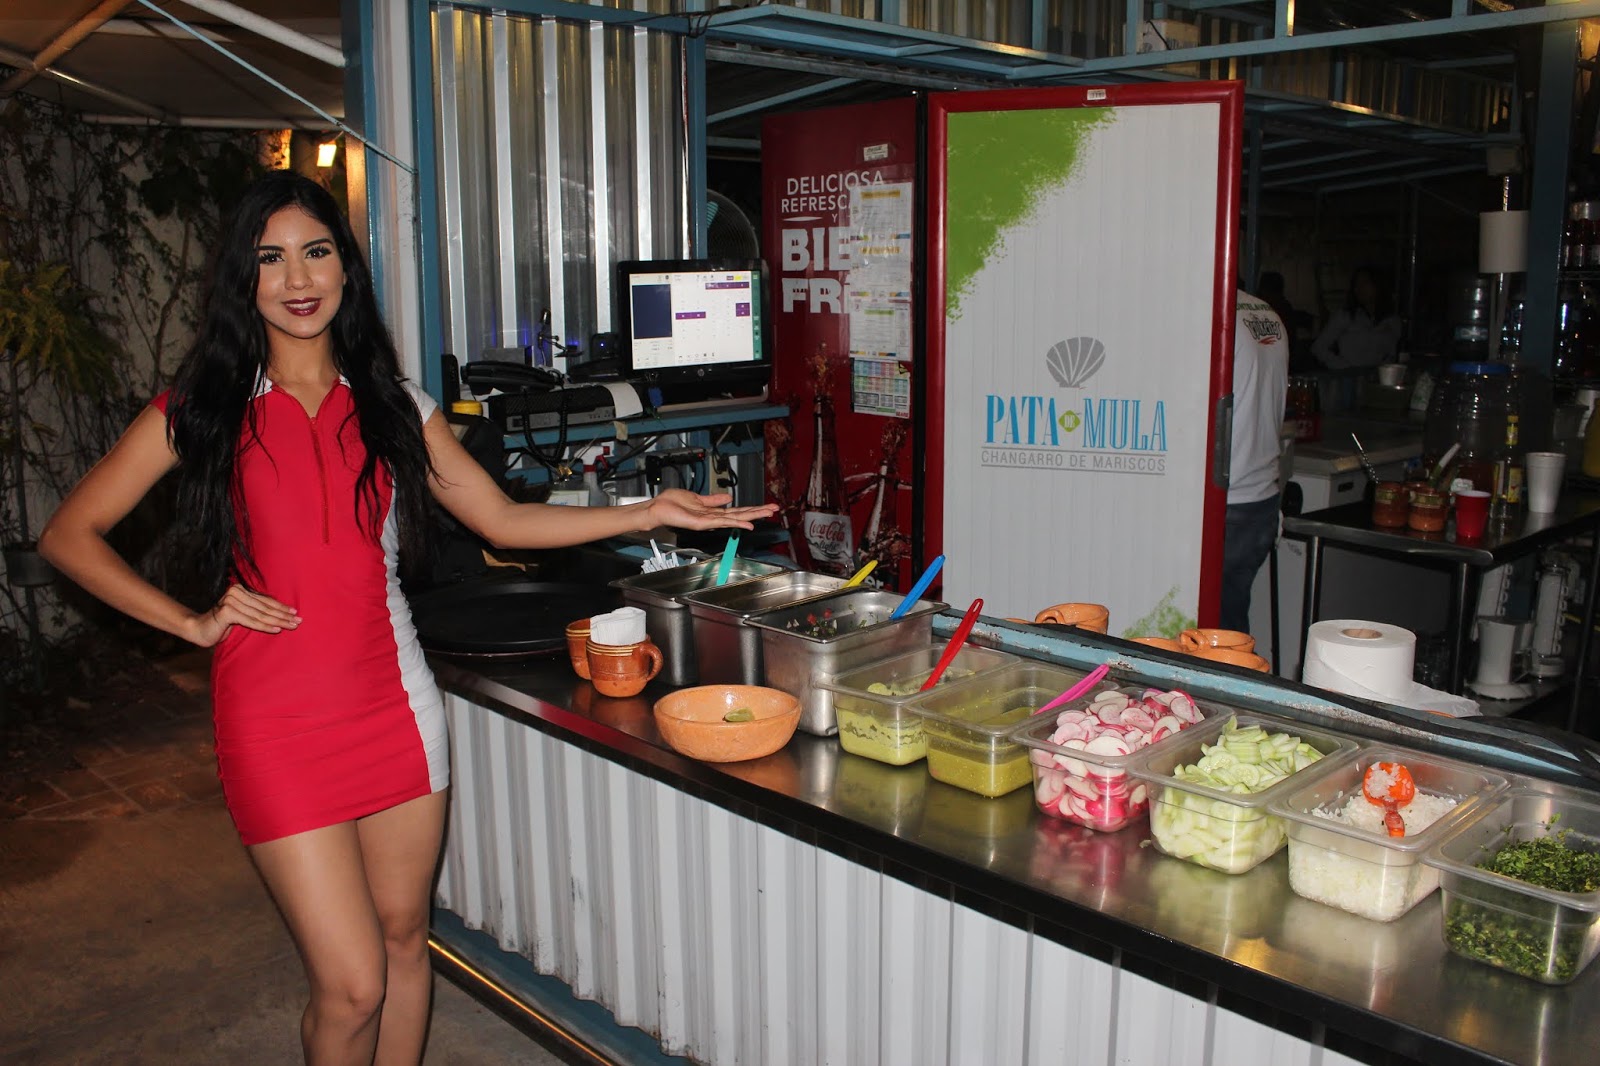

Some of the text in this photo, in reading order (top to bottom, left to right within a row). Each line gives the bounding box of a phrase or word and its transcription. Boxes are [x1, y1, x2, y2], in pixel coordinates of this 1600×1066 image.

[787, 170, 885, 195] DELICIOSA
[781, 194, 851, 213] REFRESC
[781, 227, 851, 271] BIE
[984, 394, 1168, 452] PATA DE MULA
[981, 450, 1165, 472] CHANGARRO DE MARISCOS
